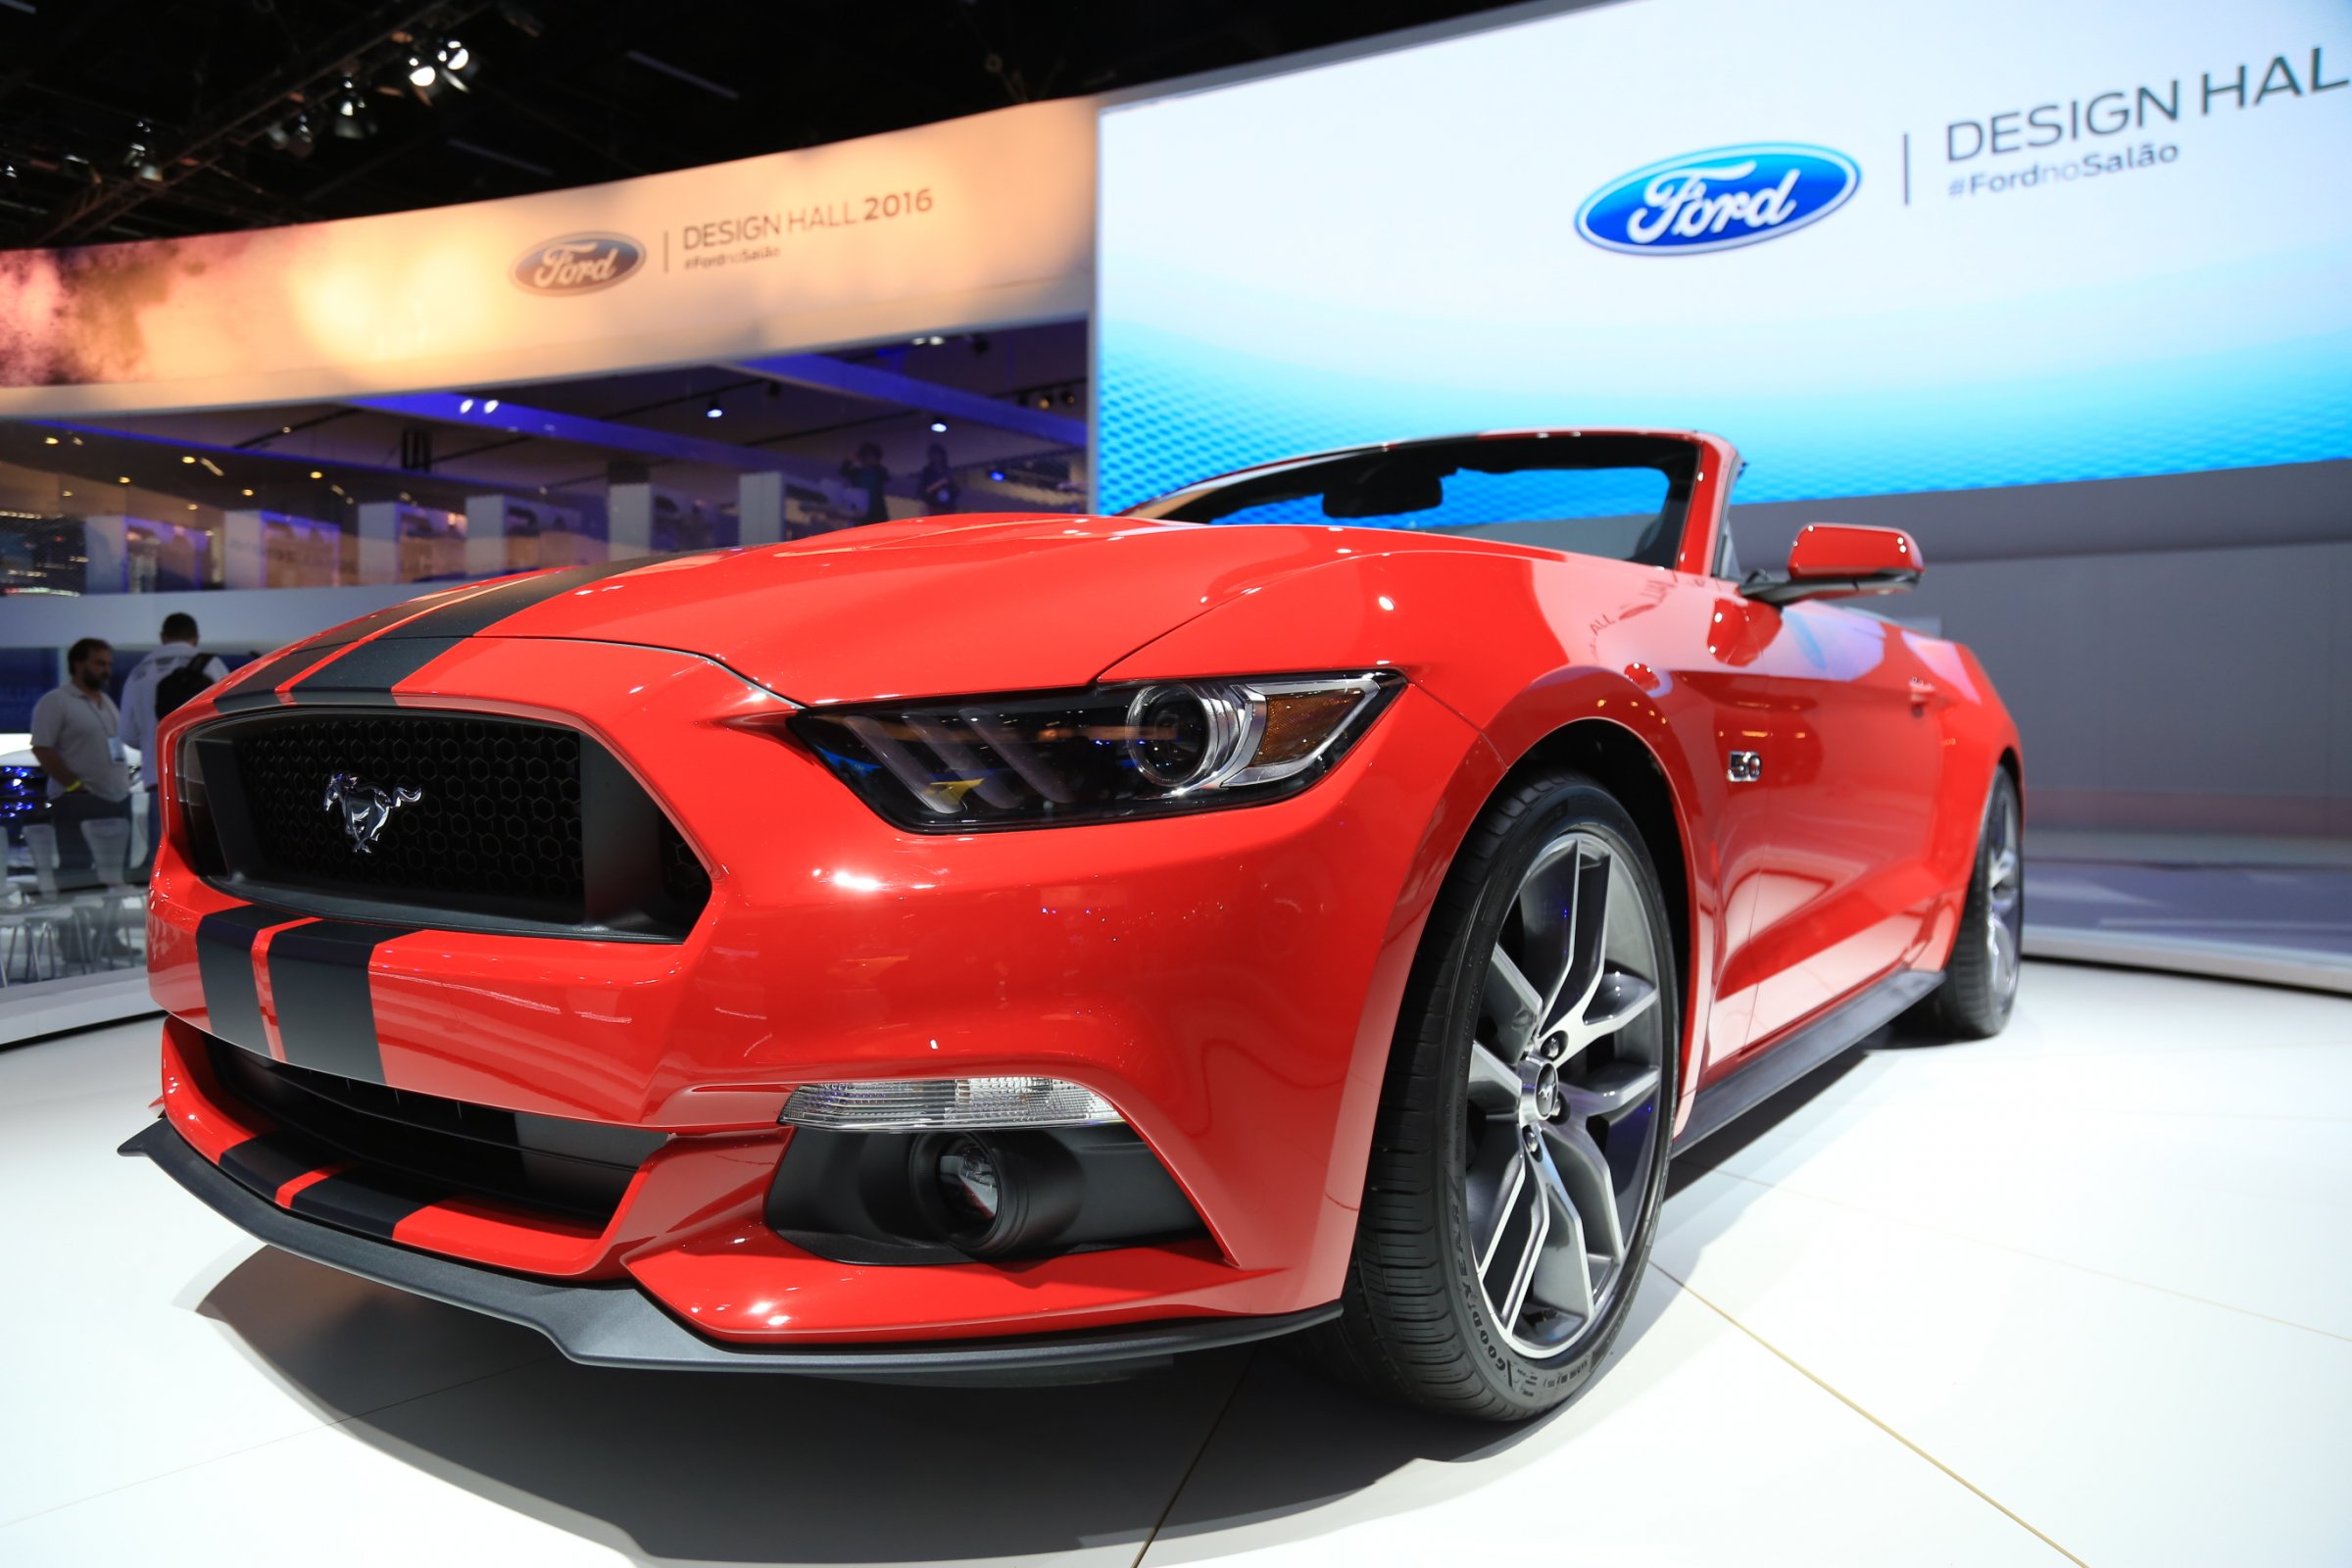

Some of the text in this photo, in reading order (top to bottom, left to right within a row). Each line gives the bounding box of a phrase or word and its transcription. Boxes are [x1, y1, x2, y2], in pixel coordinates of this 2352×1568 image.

[1946, 47, 2350, 164] DESIGN HAL
[1948, 140, 2180, 198] #FordnoSalão
[683, 188, 934, 251] DESIGN HALL 2016
[1626, 159, 1802, 245] Ford
[532, 241, 619, 289] Ford
